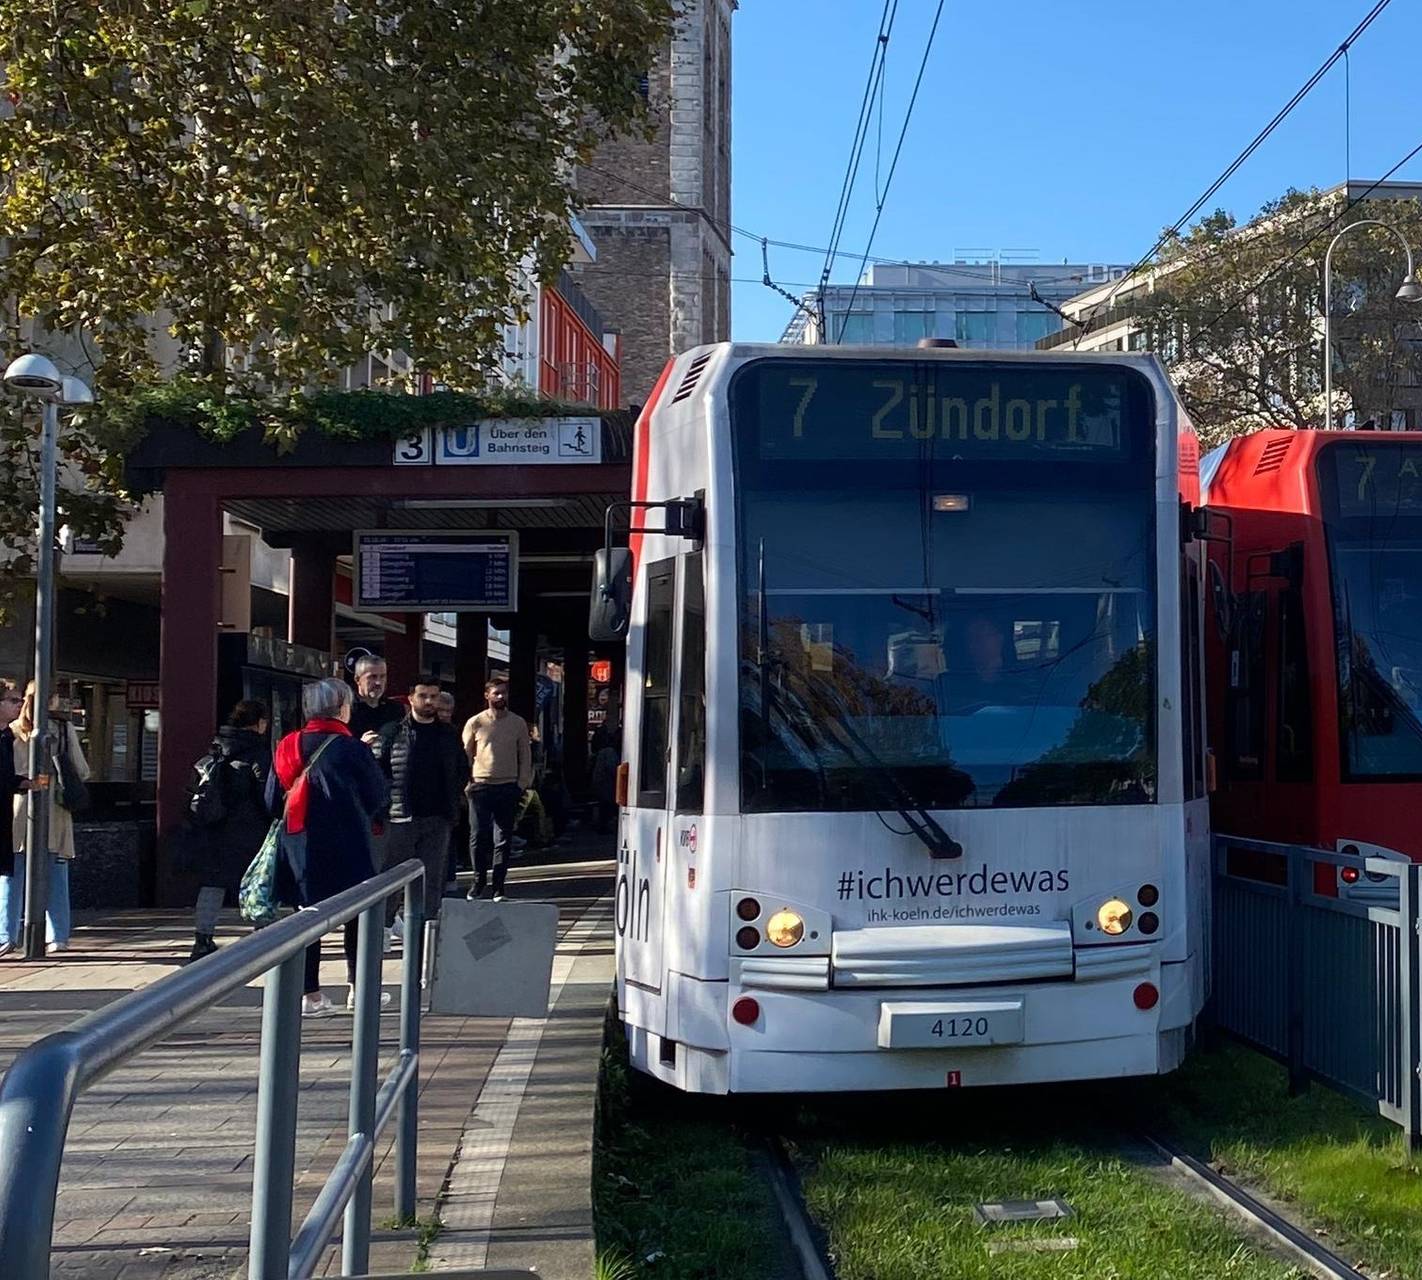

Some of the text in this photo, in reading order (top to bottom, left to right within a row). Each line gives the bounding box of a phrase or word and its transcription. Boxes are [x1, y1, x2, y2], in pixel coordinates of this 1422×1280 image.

[789, 377, 1082, 441] 7 Zündorf
[401, 430, 423, 460] 3
[490, 425, 548, 440] Über den
[487, 442, 550, 455] Bahnsteig
[1355, 456, 1377, 501] 7
[836, 863, 1070, 901] #ichwerdewas
[867, 903, 1041, 923] ihk-koeln.de/ichwerdewas
[931, 1017, 989, 1038] 4120
